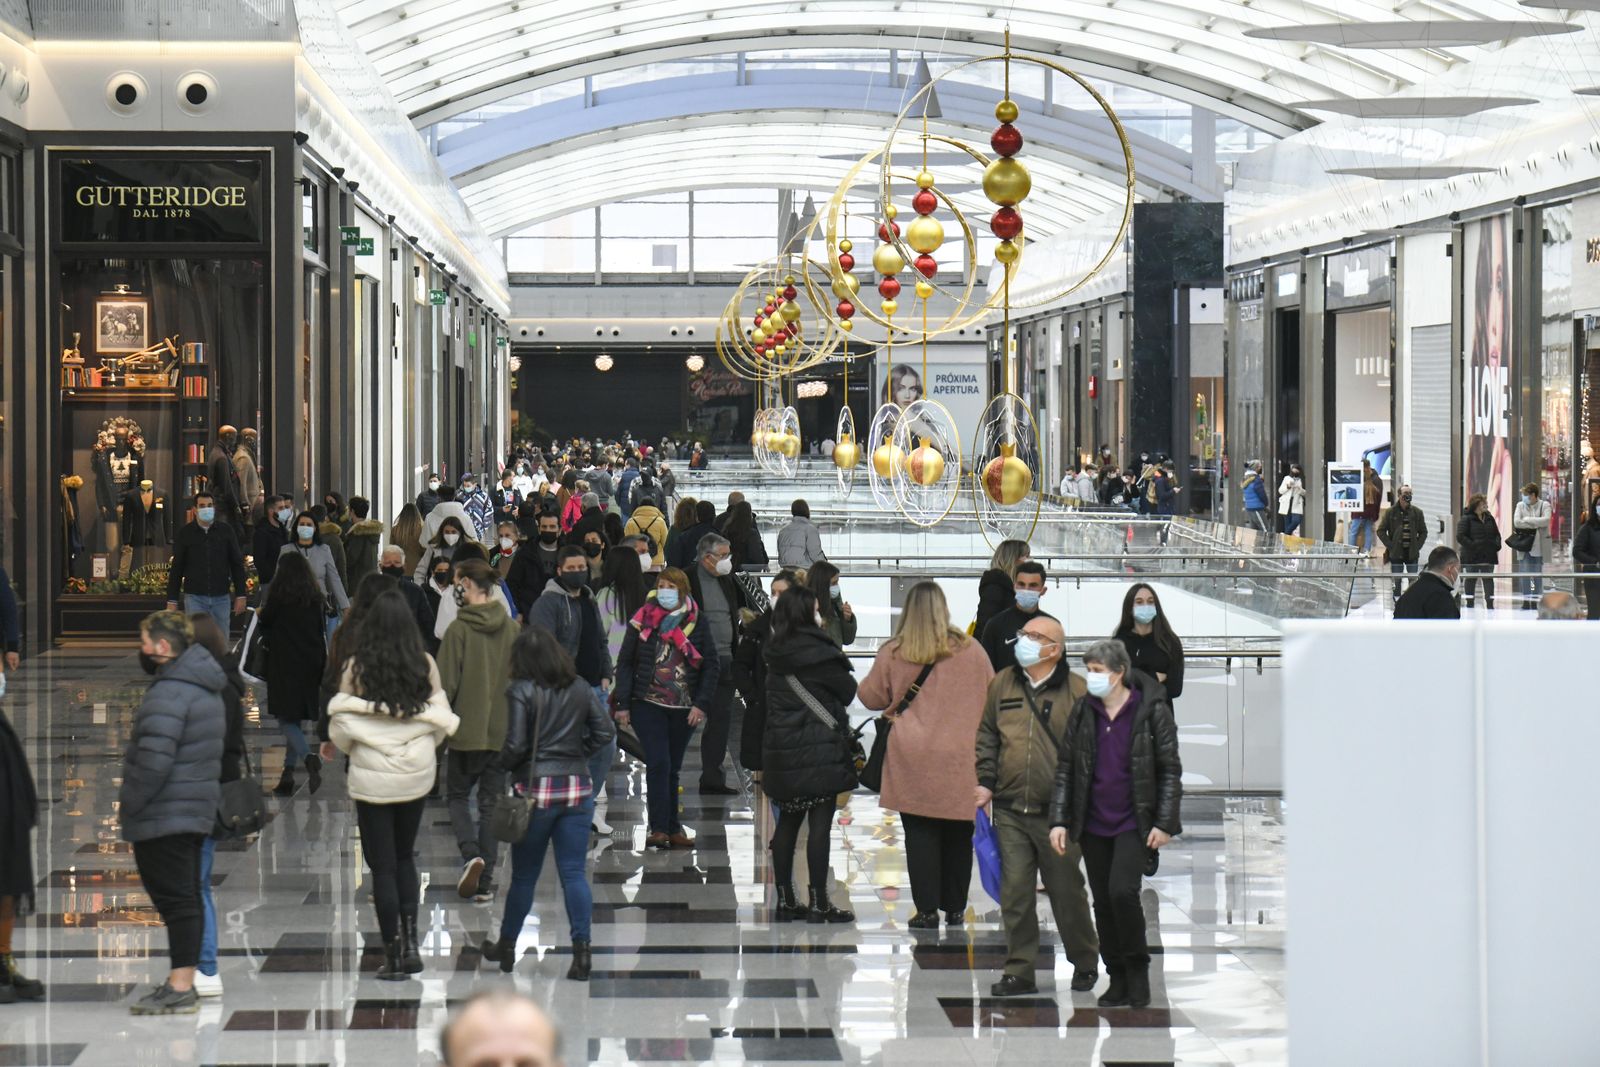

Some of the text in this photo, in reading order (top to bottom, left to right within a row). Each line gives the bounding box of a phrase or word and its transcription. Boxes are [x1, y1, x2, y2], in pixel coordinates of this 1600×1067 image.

[76, 186, 247, 207] GUTTERIDGE
[133, 208, 191, 218] DAL 1878
[935, 371, 978, 383] PRÓXIMA
[933, 385, 980, 394] APERTURA
[1474, 364, 1508, 438] LOVE
